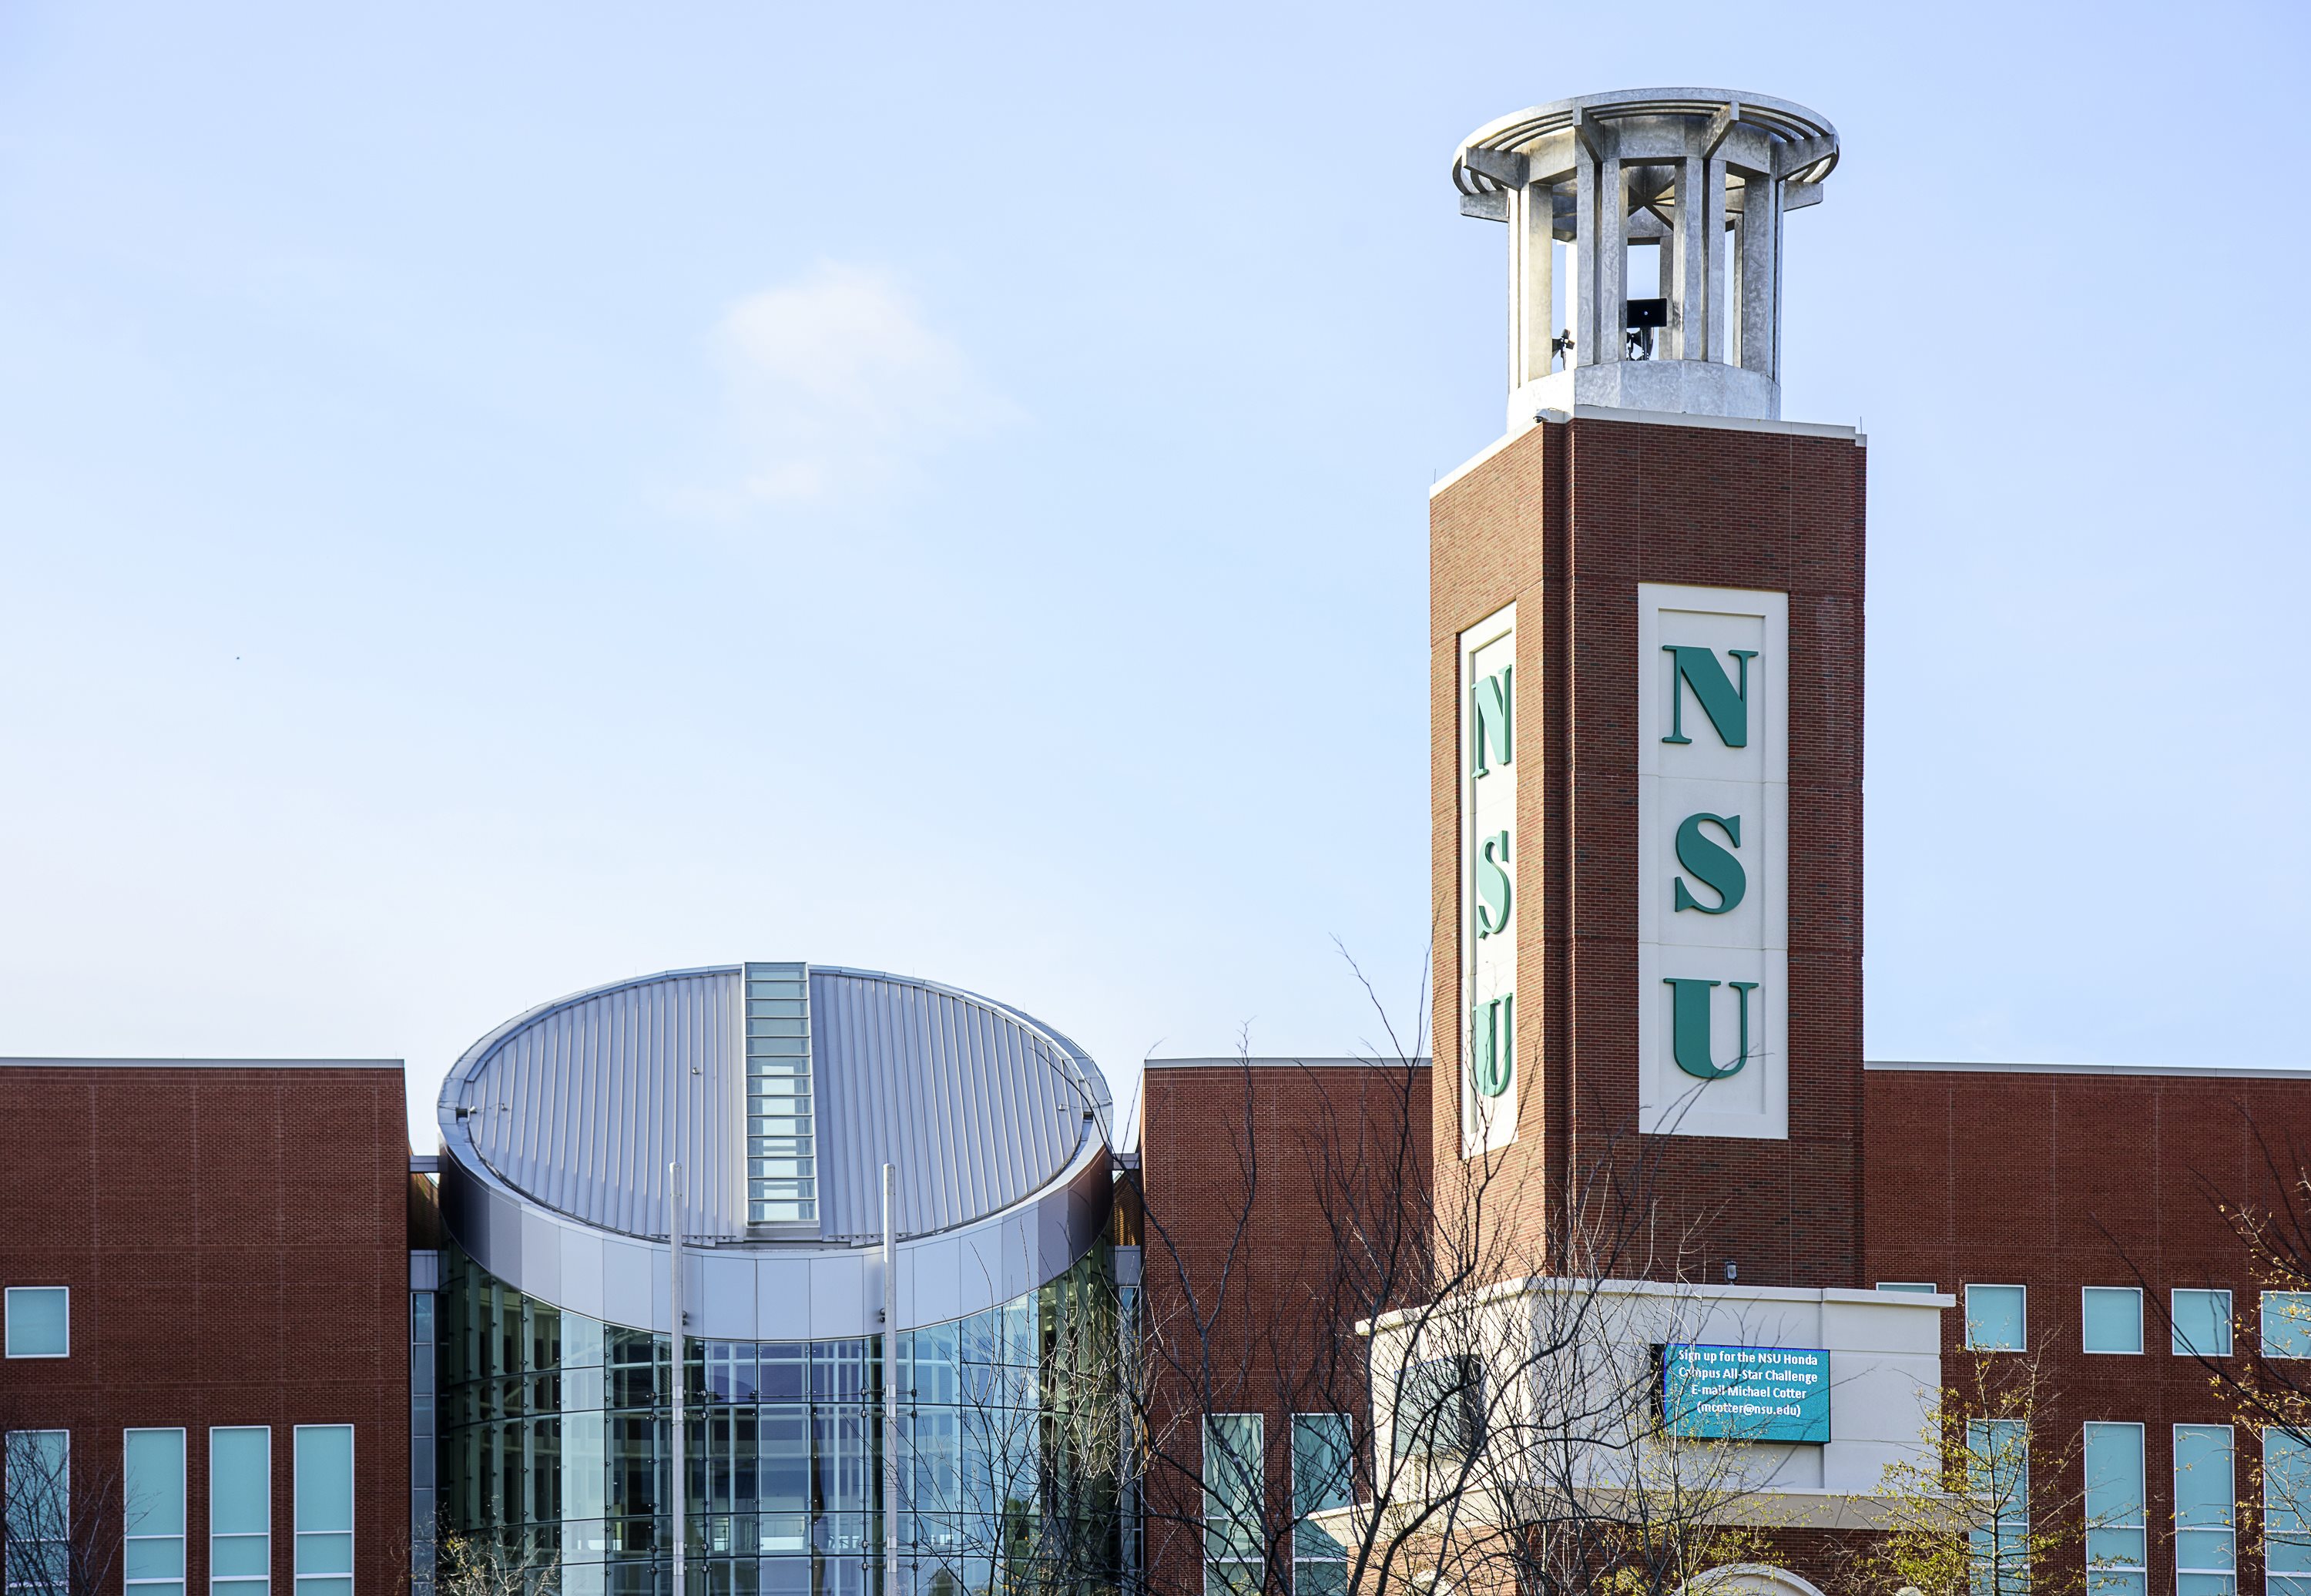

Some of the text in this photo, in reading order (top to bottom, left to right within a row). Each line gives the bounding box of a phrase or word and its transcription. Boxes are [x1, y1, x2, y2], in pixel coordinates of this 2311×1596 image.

[1662, 644, 1759, 1079] NSU
[1471, 664, 1514, 1098] NSU
[1679, 1350, 1818, 1366] Sign up for the NSU Honda
[1722, 1368, 1763, 1380] All-Star
[1765, 1370, 1818, 1384] Challenge
[1692, 1384, 1807, 1399] E-mail Michael Cotter
[1697, 1400, 1801, 1417] (mcotter@nsu.edu)
